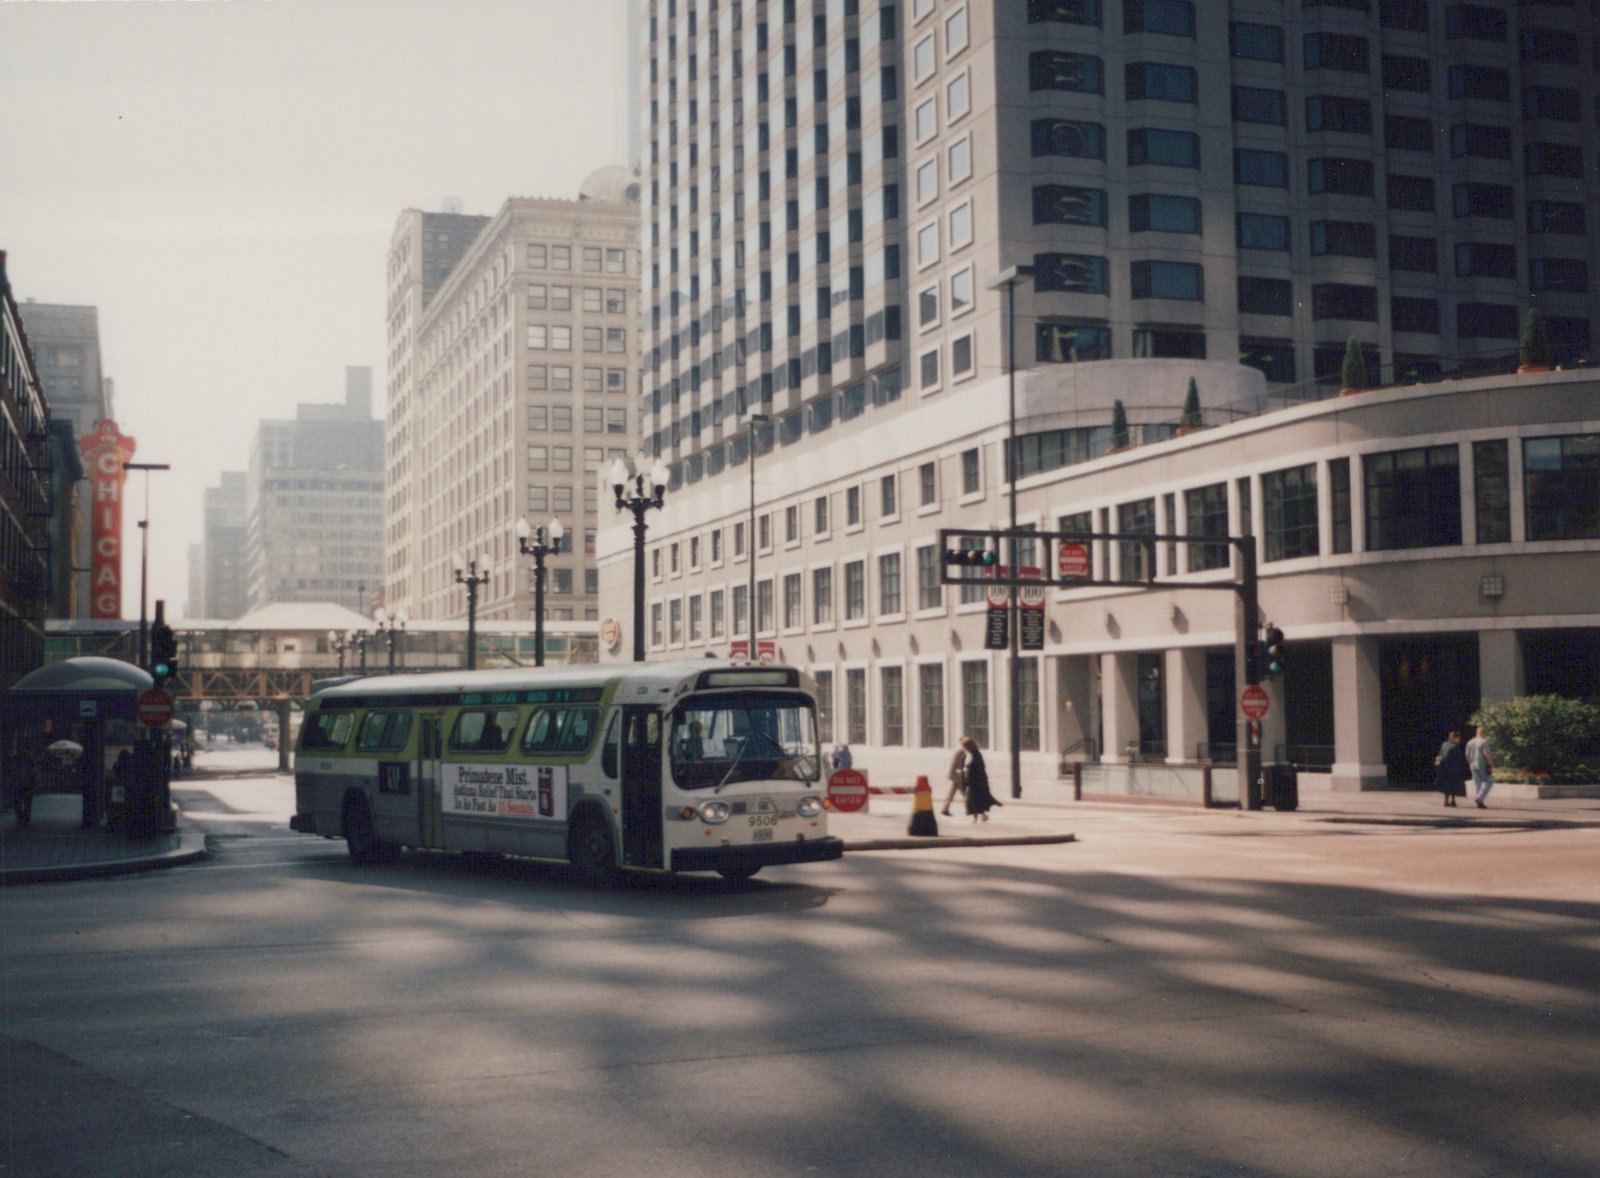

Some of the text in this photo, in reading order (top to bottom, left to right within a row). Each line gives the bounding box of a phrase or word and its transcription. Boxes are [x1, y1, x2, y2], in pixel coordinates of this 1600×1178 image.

[459, 766, 503, 784] Primatene
[478, 785, 497, 798] Relief
[497, 786, 514, 799] That
[515, 787, 537, 800] Starts
[488, 800, 496, 812] As
[835, 796, 862, 804] ENTER
[748, 815, 778, 827] 9506
